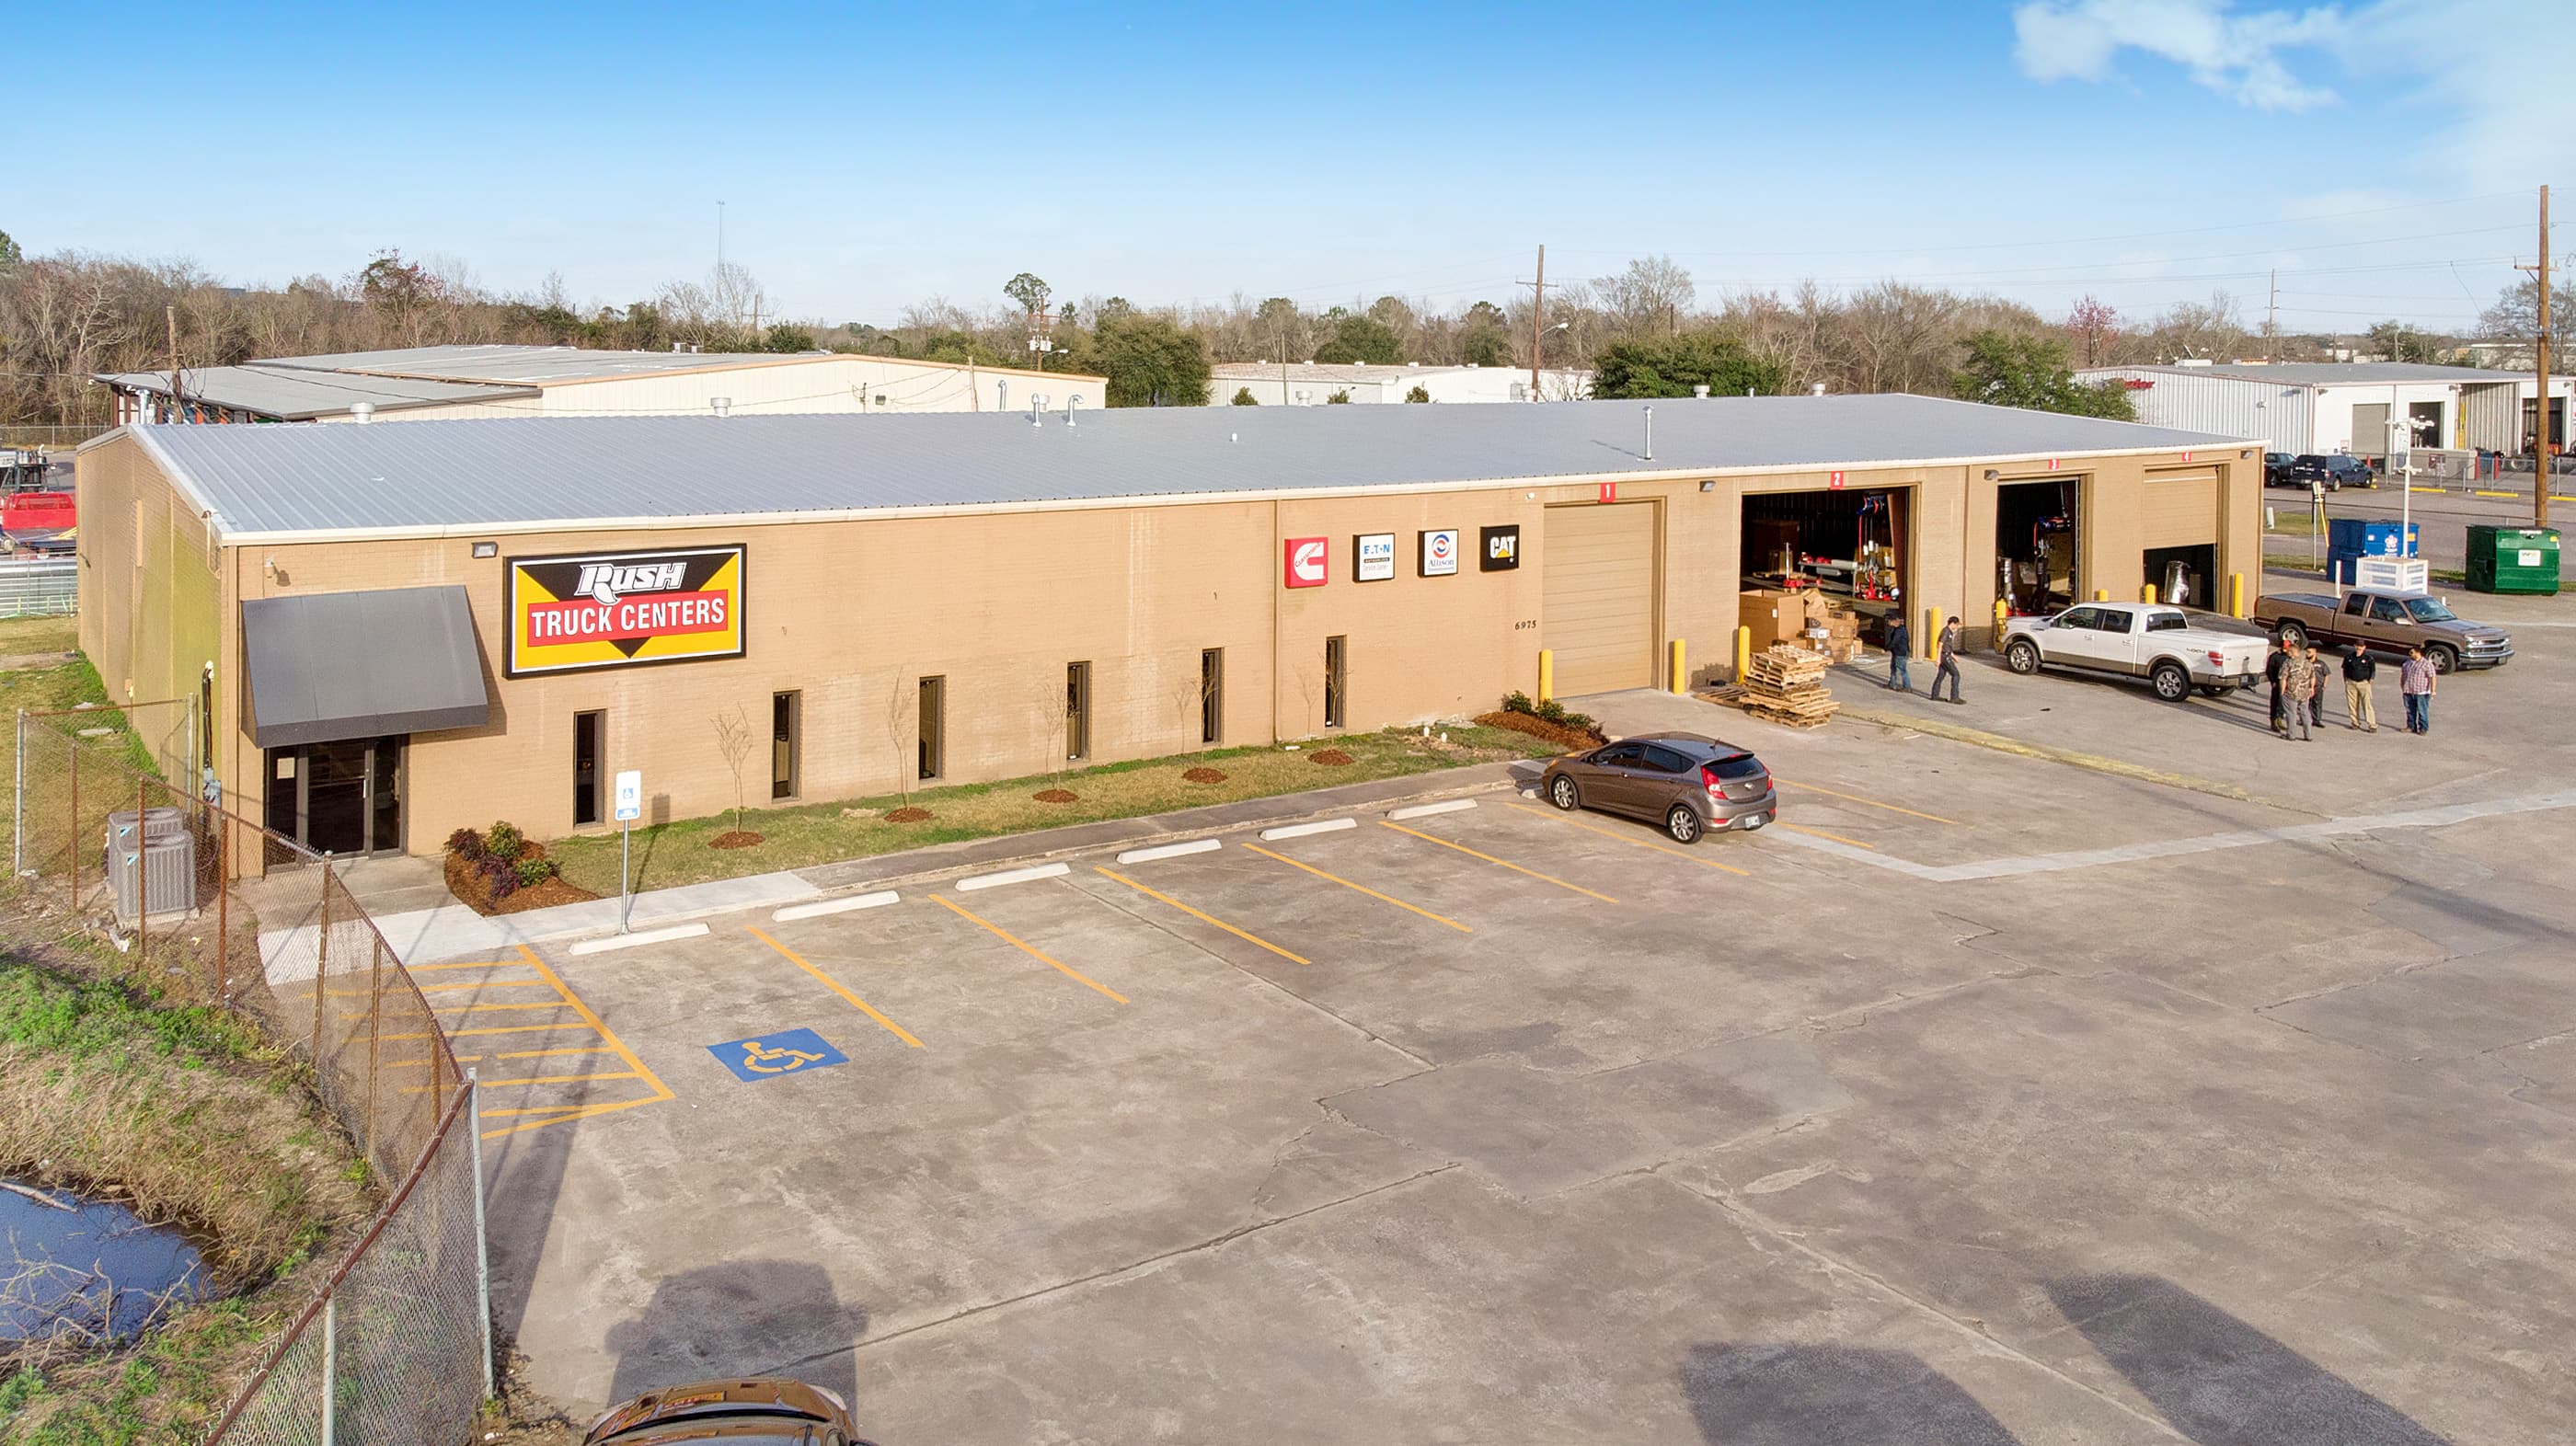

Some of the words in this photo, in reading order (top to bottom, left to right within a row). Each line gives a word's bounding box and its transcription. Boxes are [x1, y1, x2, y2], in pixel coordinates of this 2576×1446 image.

[1834, 472, 1840, 486] 2
[1605, 484, 1610, 498] 1
[1489, 535, 1516, 558] CAT
[1428, 558, 1454, 568] Allison
[573, 562, 687, 605] RUSH
[531, 605, 613, 637] TRUCK
[621, 598, 725, 631] CENTERS
[1514, 619, 1537, 631] 6975
